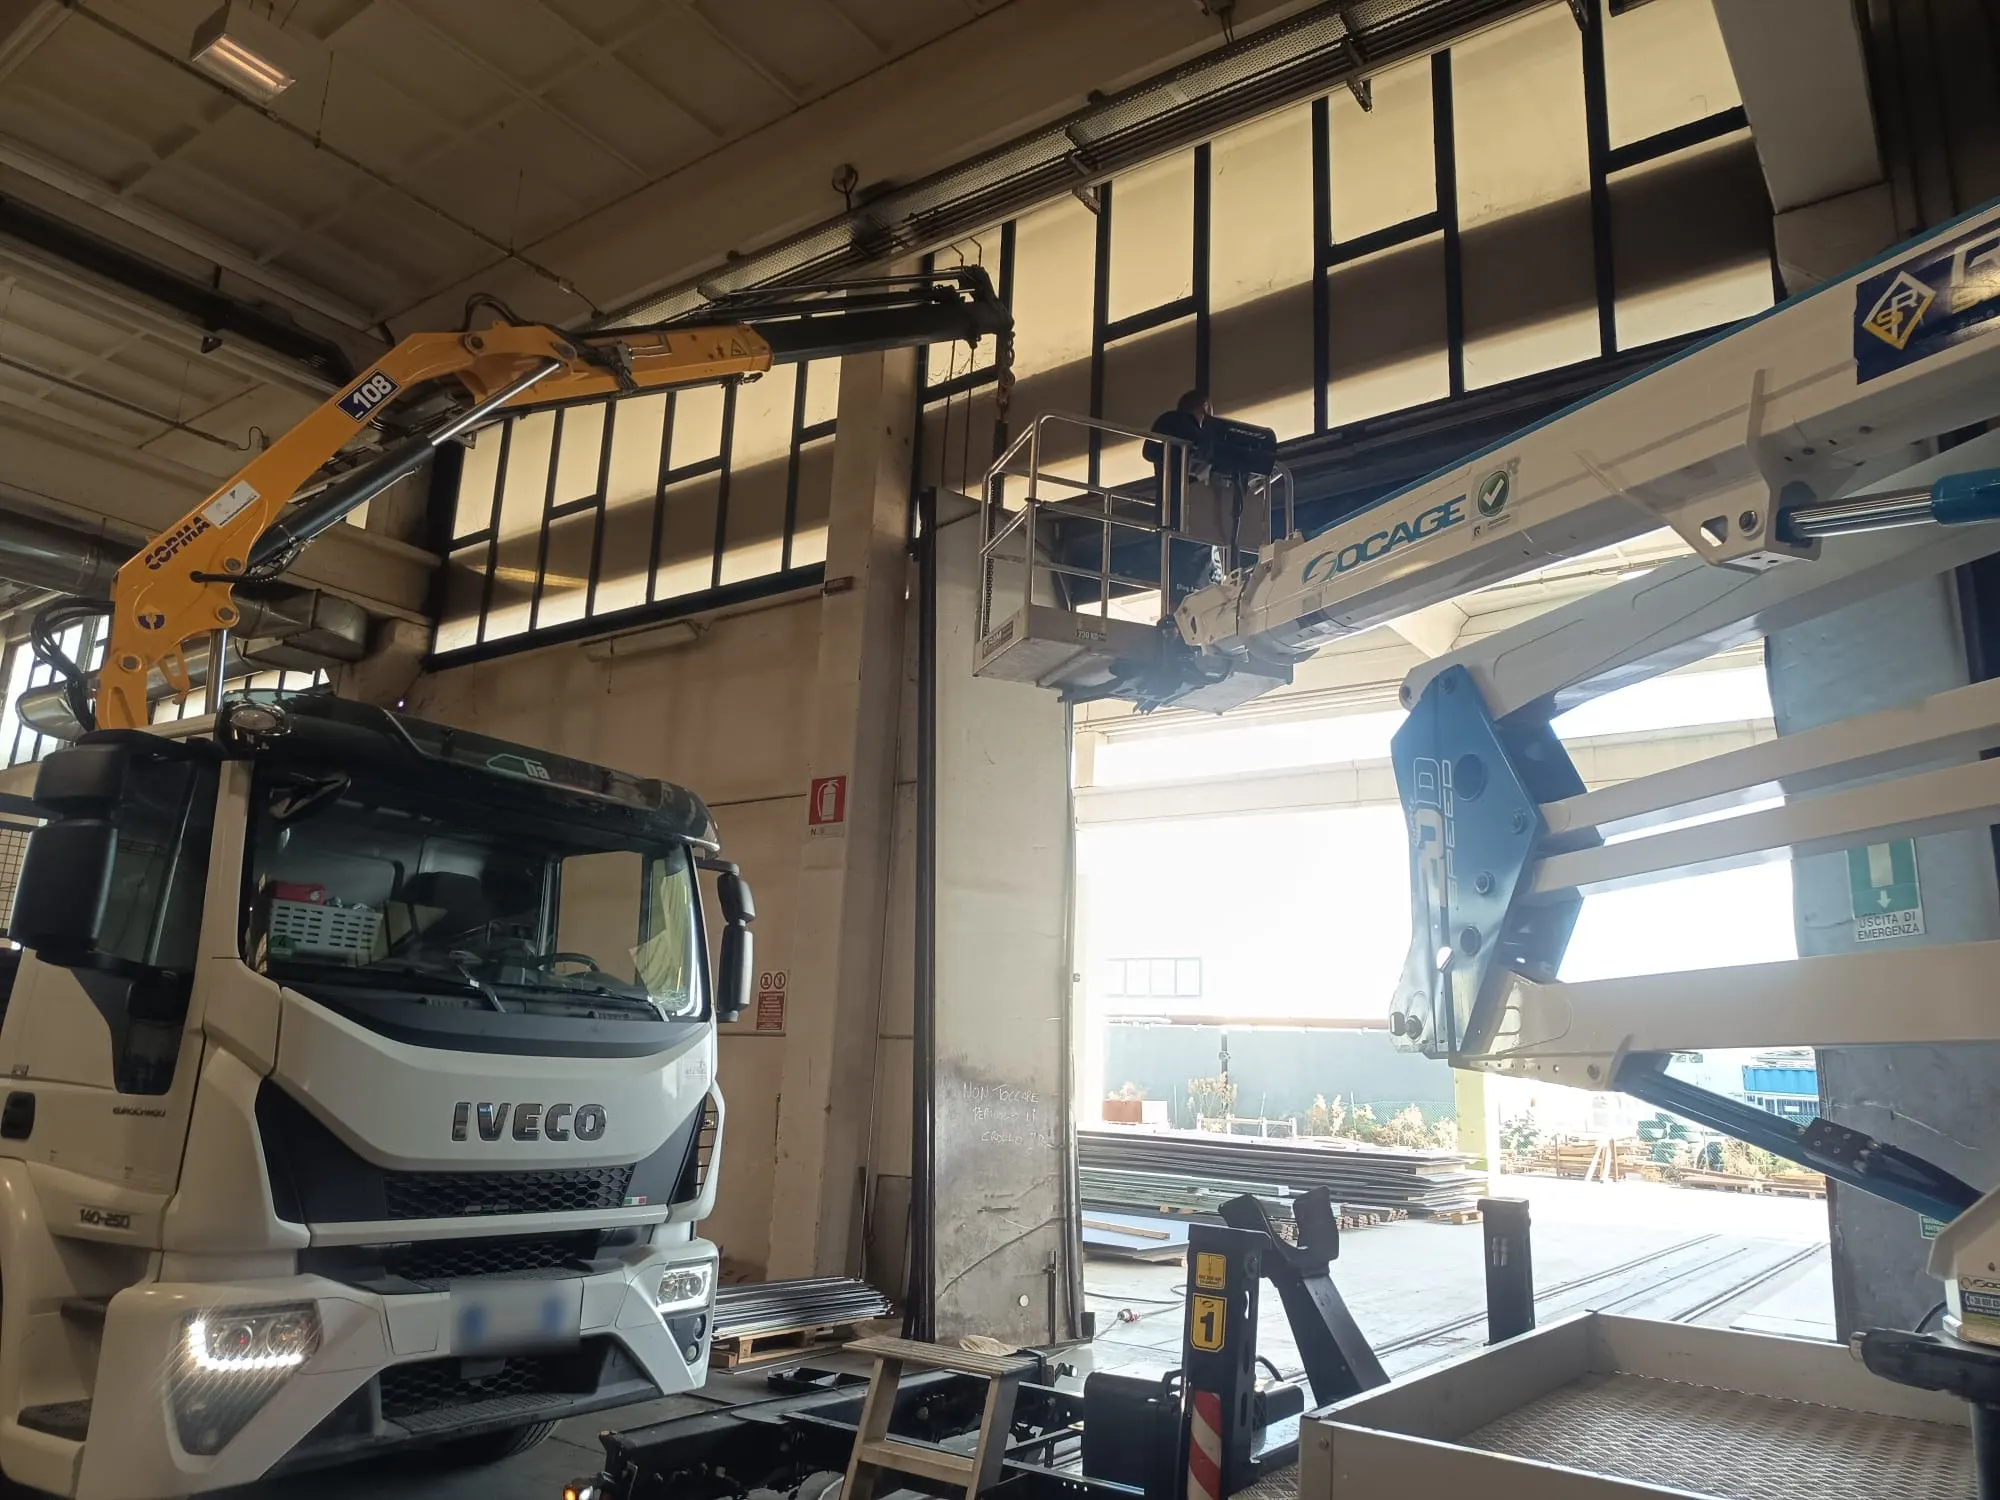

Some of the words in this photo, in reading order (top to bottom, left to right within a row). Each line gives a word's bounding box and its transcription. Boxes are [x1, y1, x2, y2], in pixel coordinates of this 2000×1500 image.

[353, 375, 392, 409] 108
[145, 516, 210, 570] COPMA
[1857, 923, 1920, 940] EMERGENZA
[1859, 913, 1899, 929] USCITA
[1904, 911, 1916, 924] DI
[963, 1081, 989, 1101] NON
[451, 1102, 608, 1142] IVECO
[1200, 1311, 1214, 1342] 1
